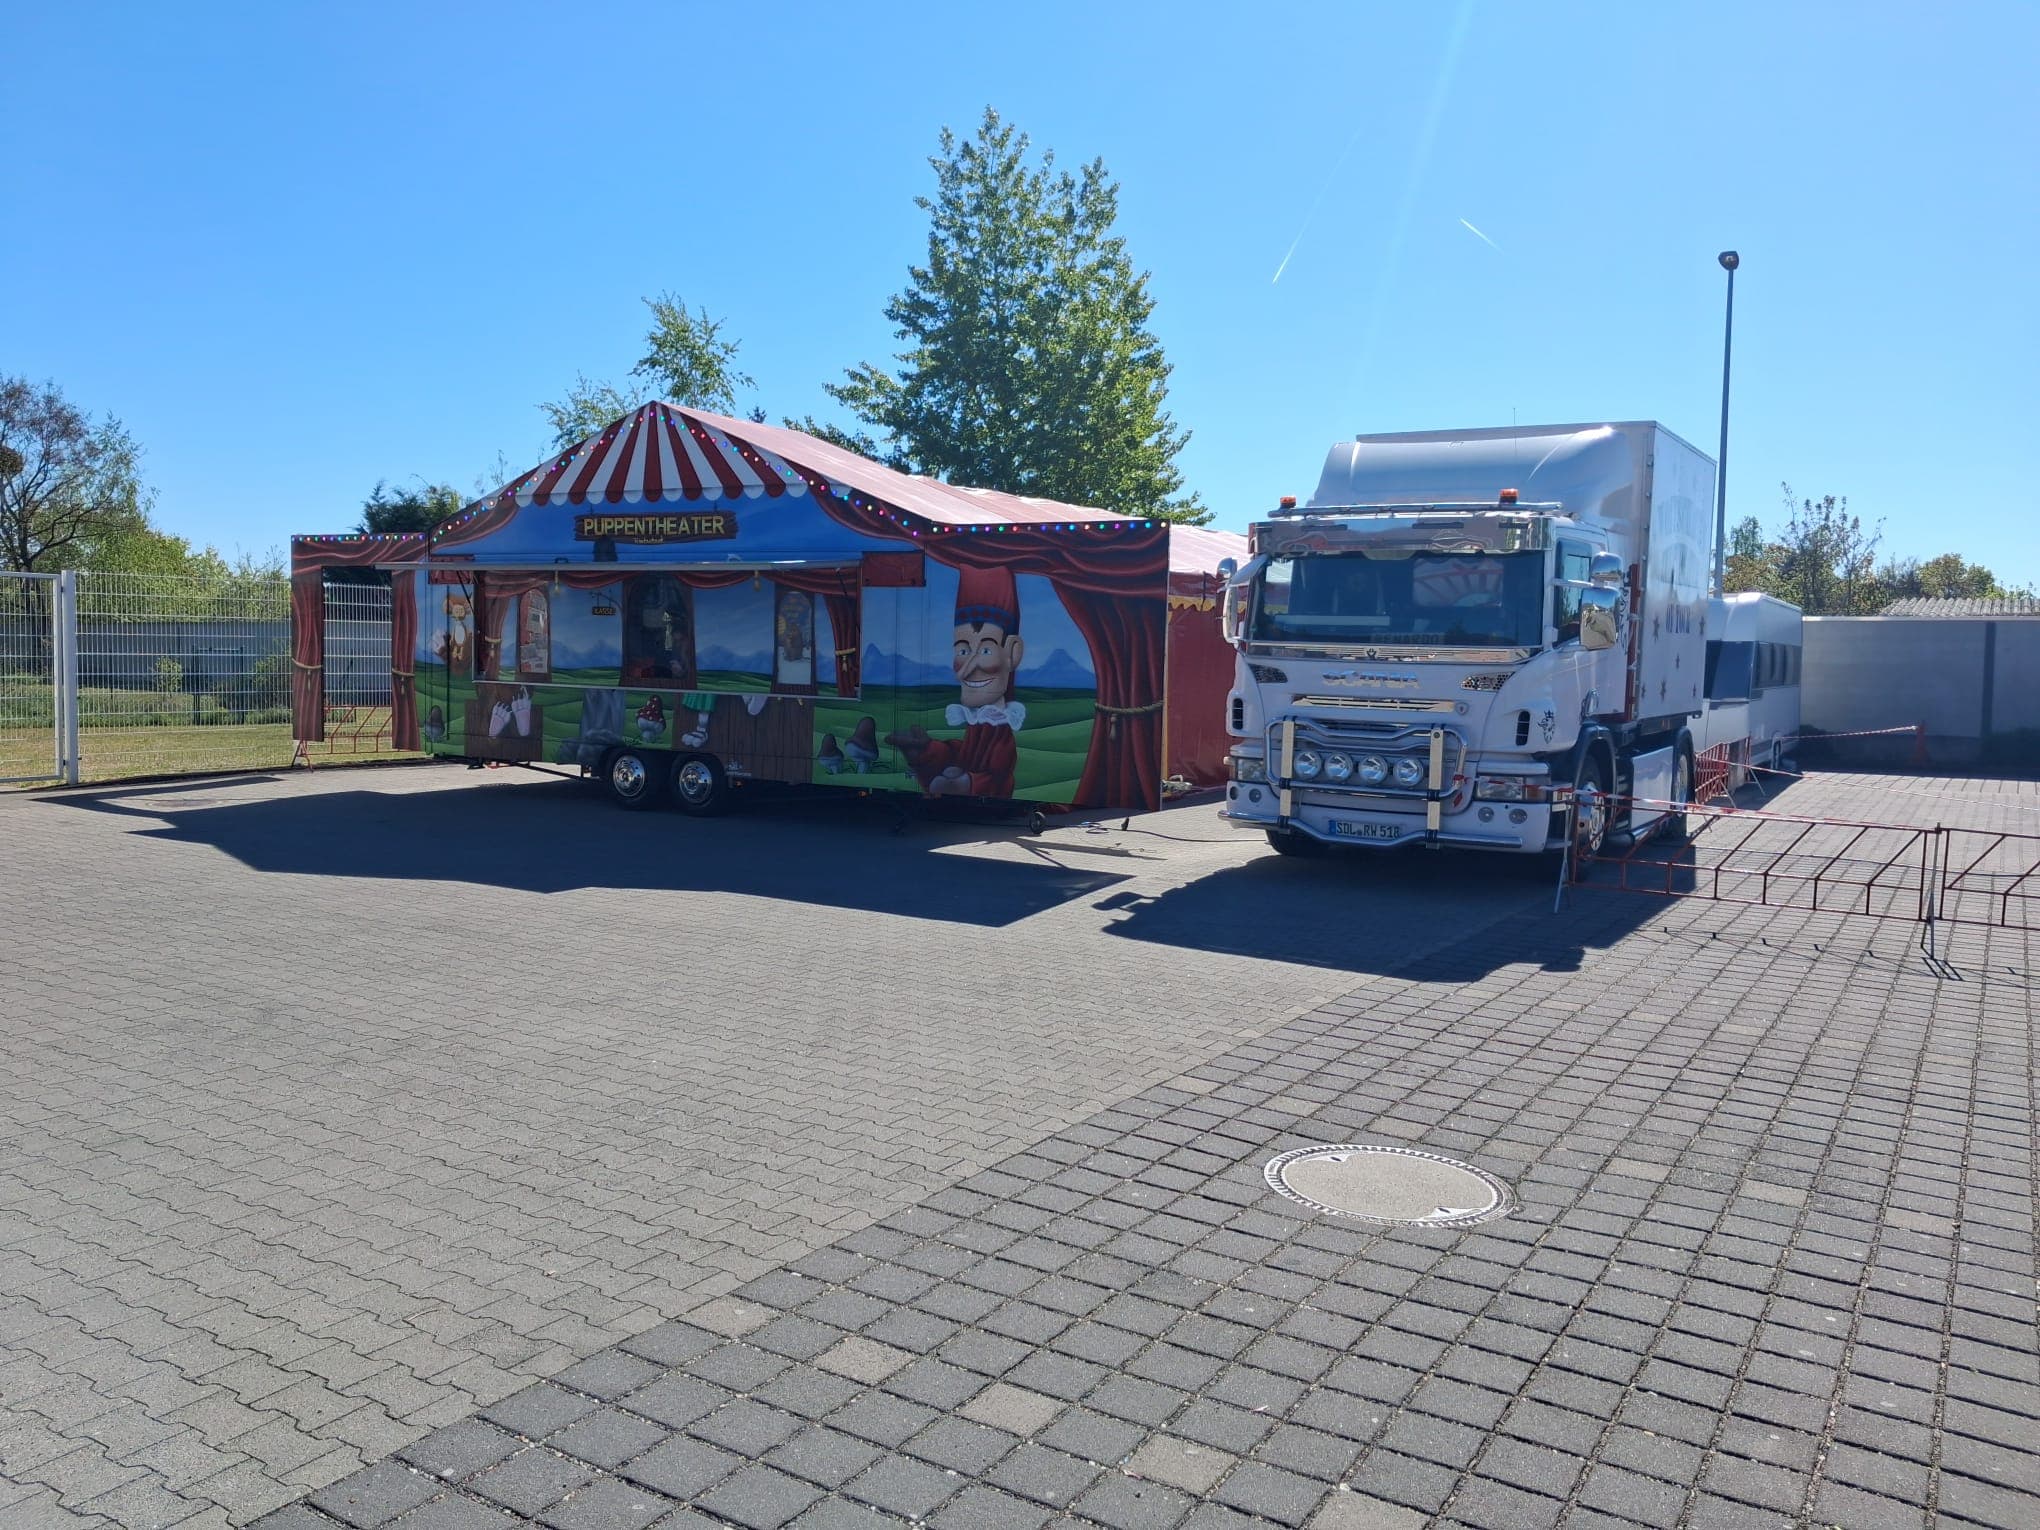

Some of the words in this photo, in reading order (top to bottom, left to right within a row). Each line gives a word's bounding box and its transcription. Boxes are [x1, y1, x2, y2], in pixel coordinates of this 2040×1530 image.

[583, 515, 725, 537] PUPPENTHEATER
[1321, 670, 1421, 689] SCANIA
[1363, 824, 1377, 837] RW
[1380, 825, 1401, 839] 518
